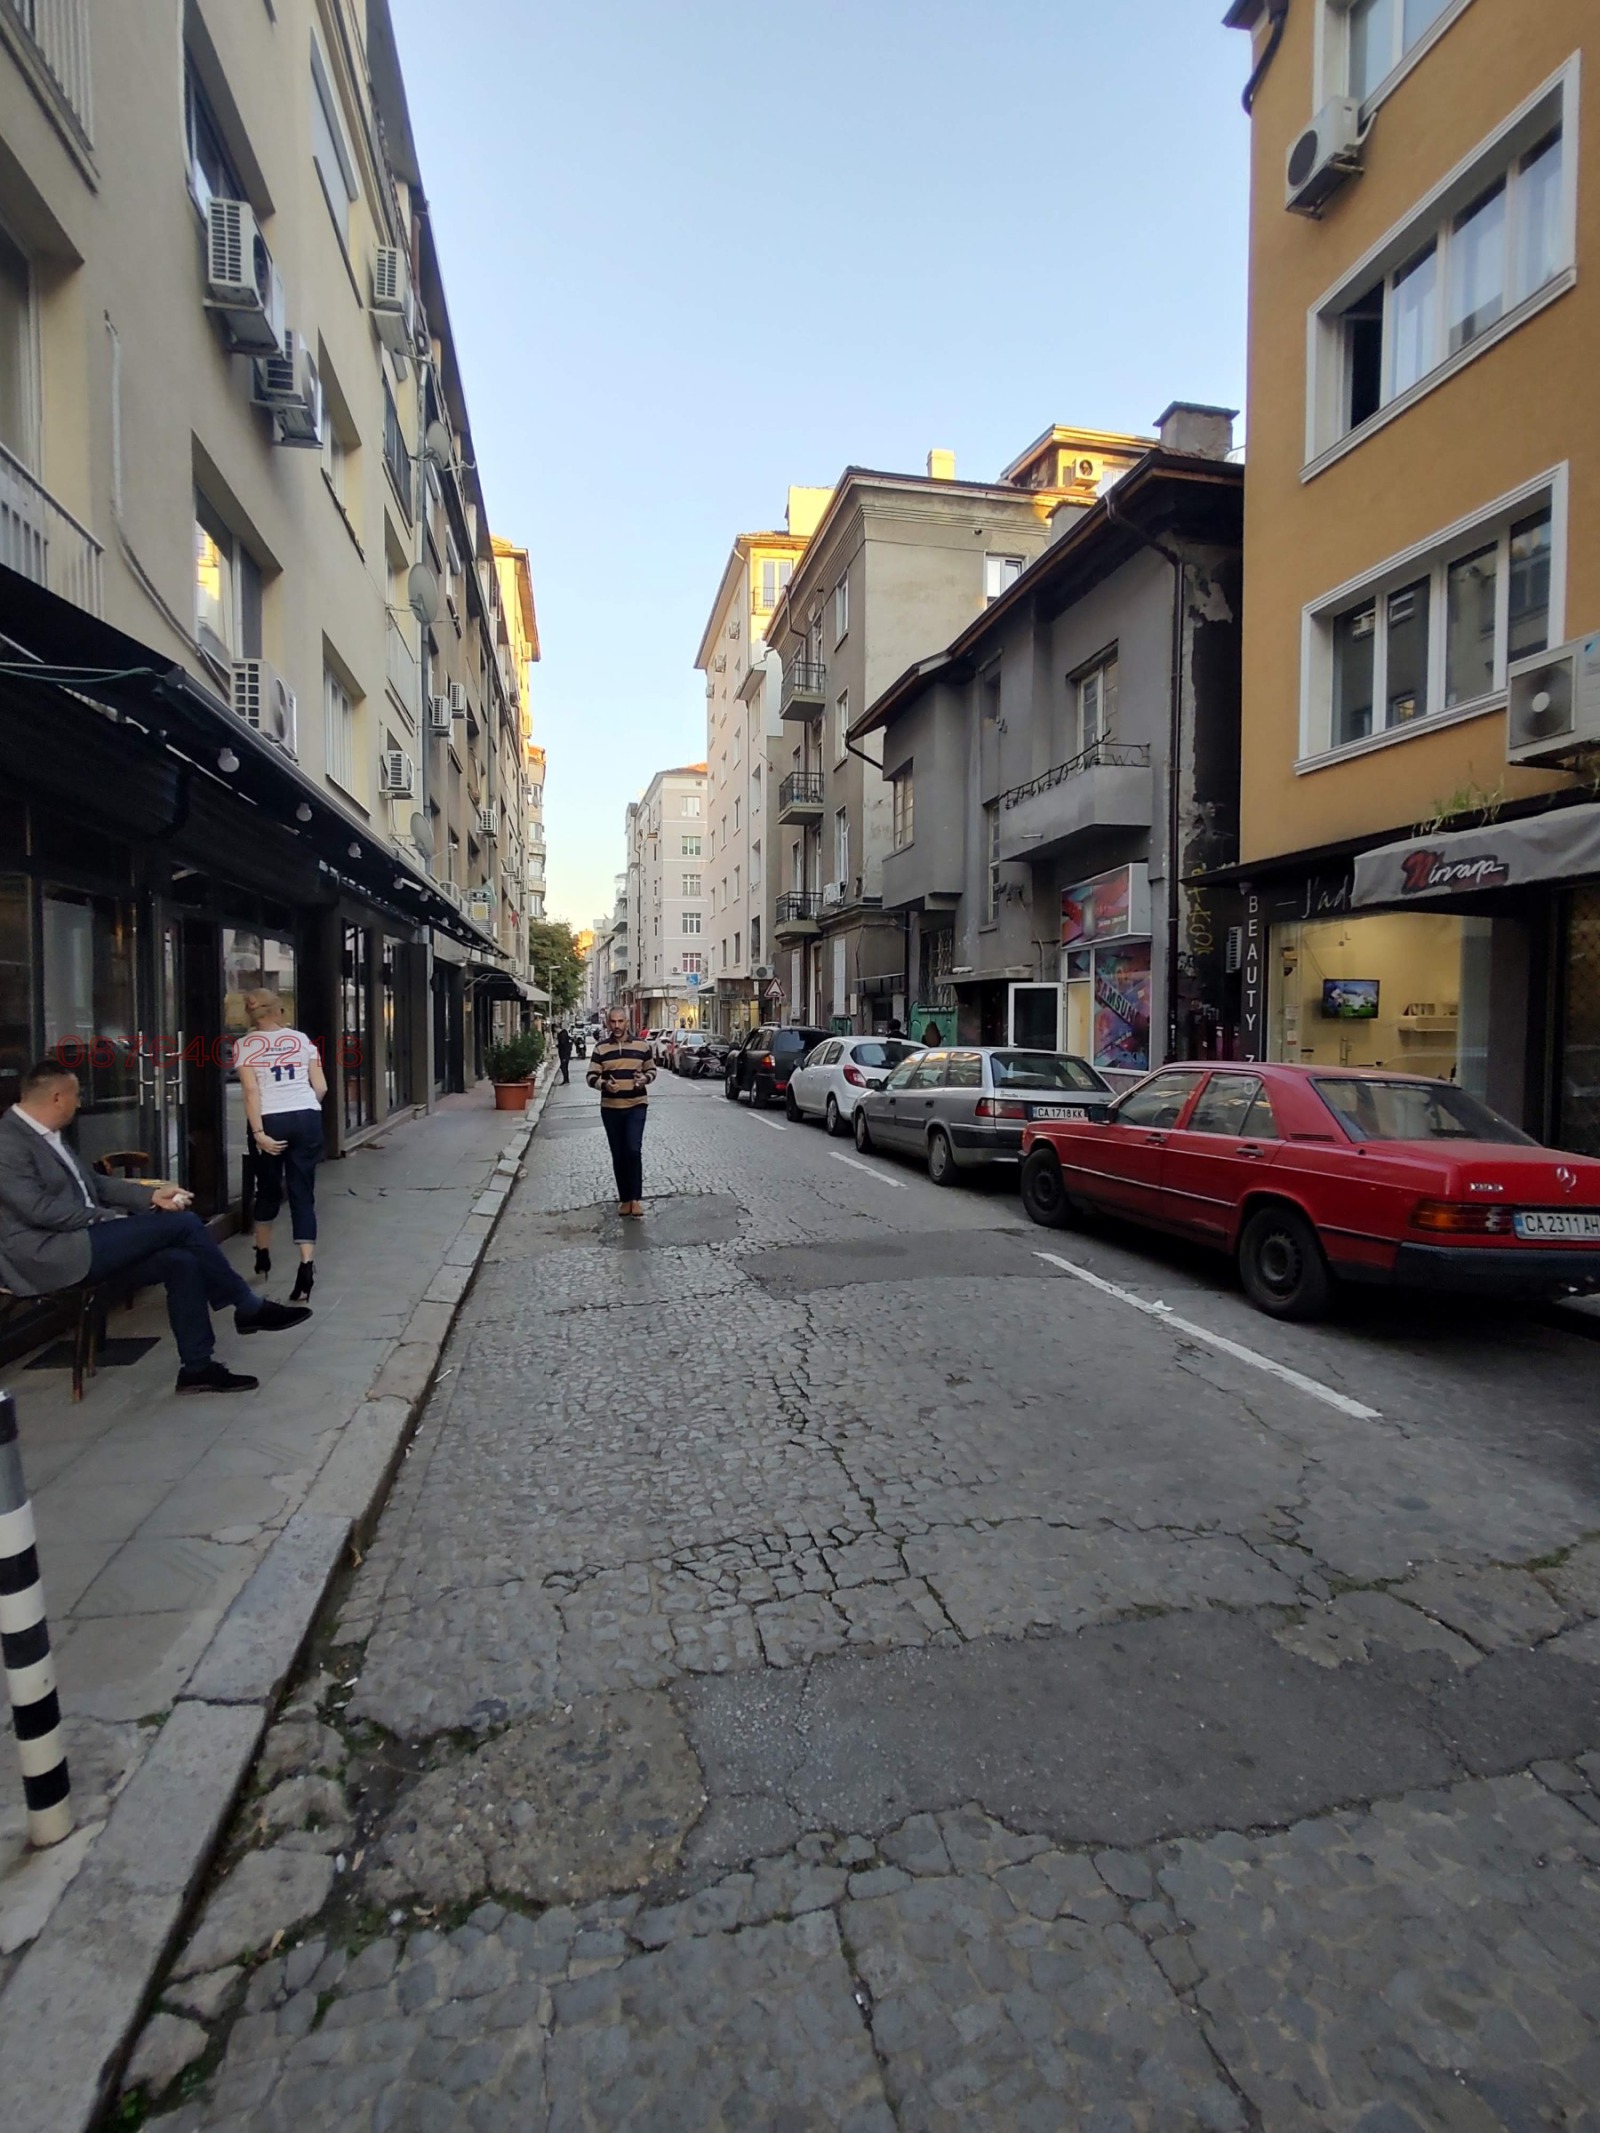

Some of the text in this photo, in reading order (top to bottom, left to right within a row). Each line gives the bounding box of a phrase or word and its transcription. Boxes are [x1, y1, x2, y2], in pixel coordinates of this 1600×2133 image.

[1301, 875, 1352, 918] J'ad
[1246, 895, 1258, 1031] BEAUTY
[1095, 976, 1139, 1024] SAMSUN
[270, 1063, 295, 1081] 11
